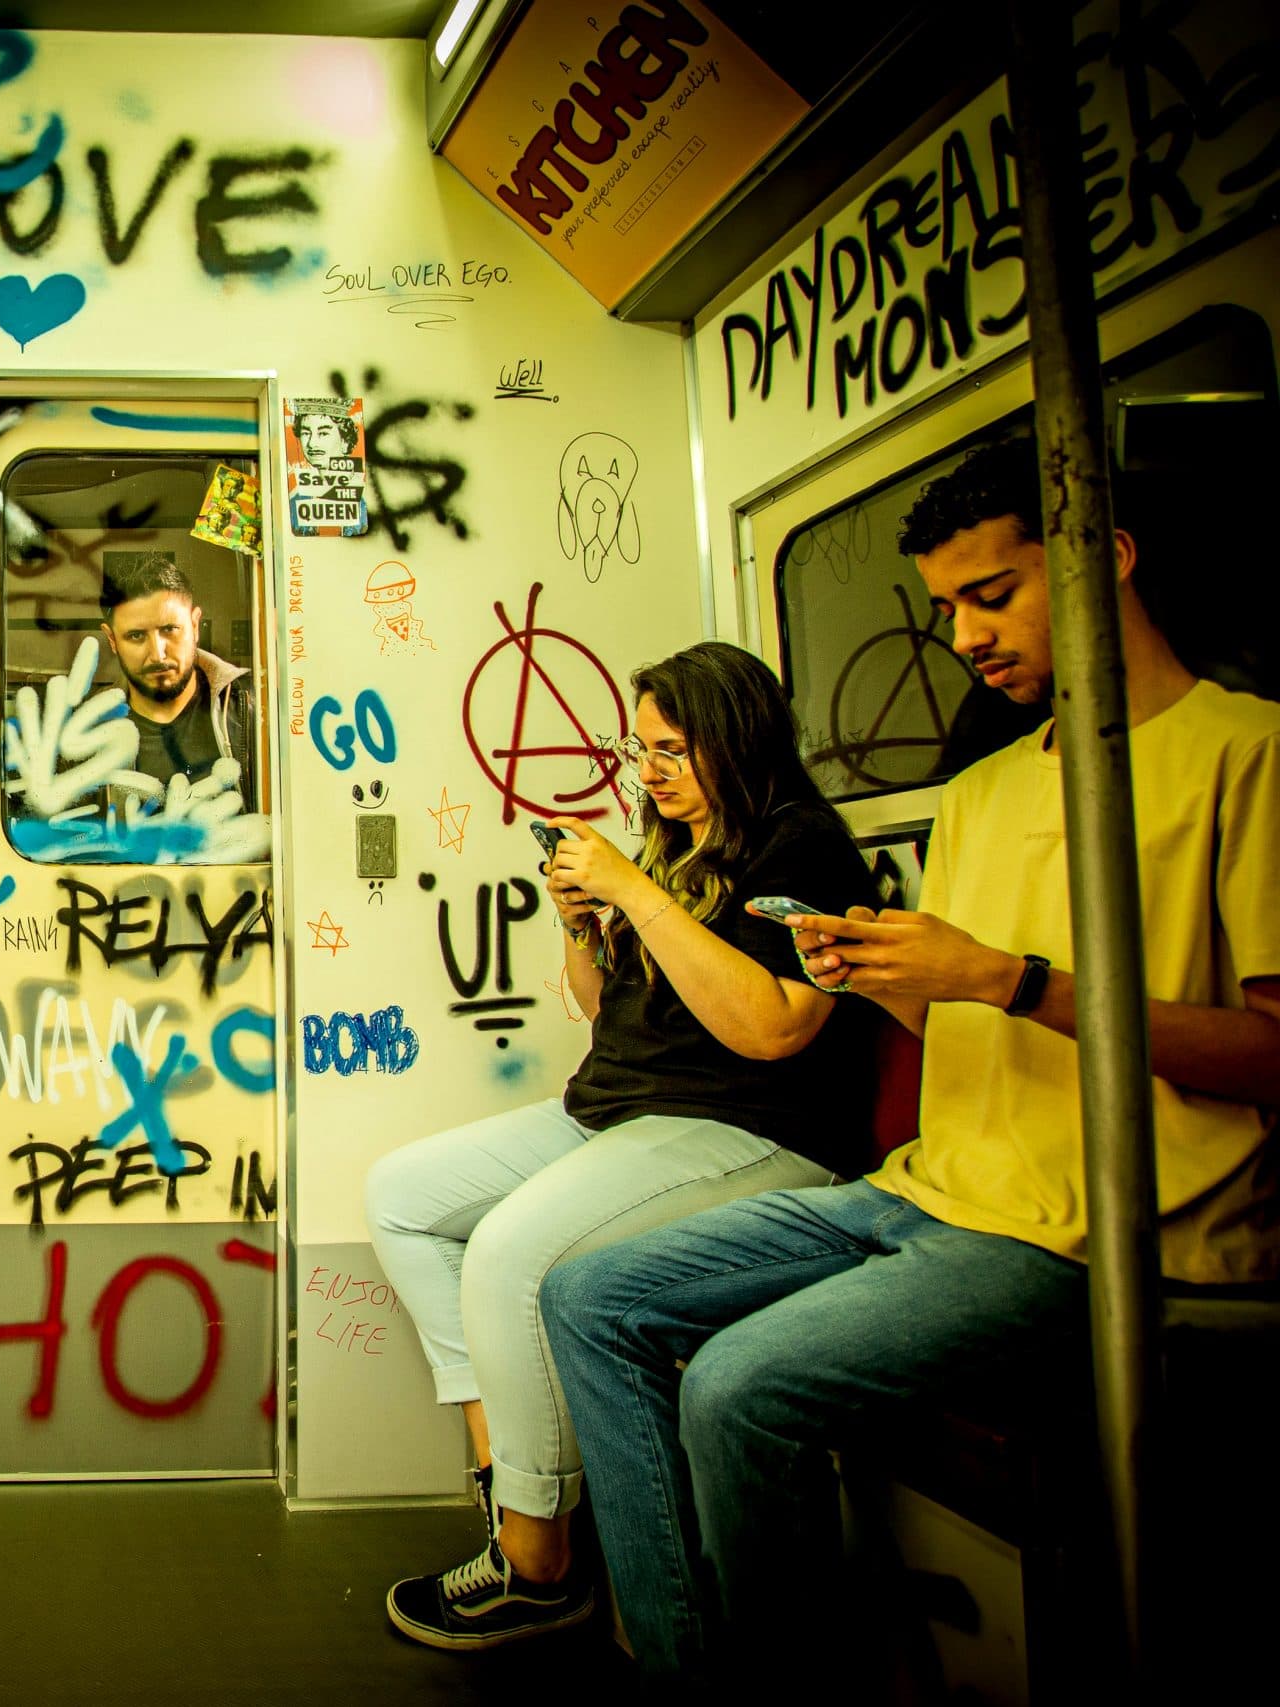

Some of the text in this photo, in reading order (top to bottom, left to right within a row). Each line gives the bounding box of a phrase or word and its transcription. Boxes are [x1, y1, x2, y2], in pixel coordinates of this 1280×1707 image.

[496, 0, 710, 236] KITCHEN
[559, 209, 586, 251] your
[630, 115, 673, 161] escape
[322, 263, 387, 296] SOUL
[391, 264, 452, 288] OVER
[298, 472, 351, 487] Save
[330, 459, 355, 472] GOD
[334, 487, 358, 500] THE
[297, 502, 359, 522] QUEEN
[289, 554, 306, 736] FOLLOW YOUR DREAMS
[308, 687, 397, 772] GO
[437, 876, 541, 999] UP
[300, 1004, 420, 1077] BOMB
[8, 1133, 213, 1238] PEEP
